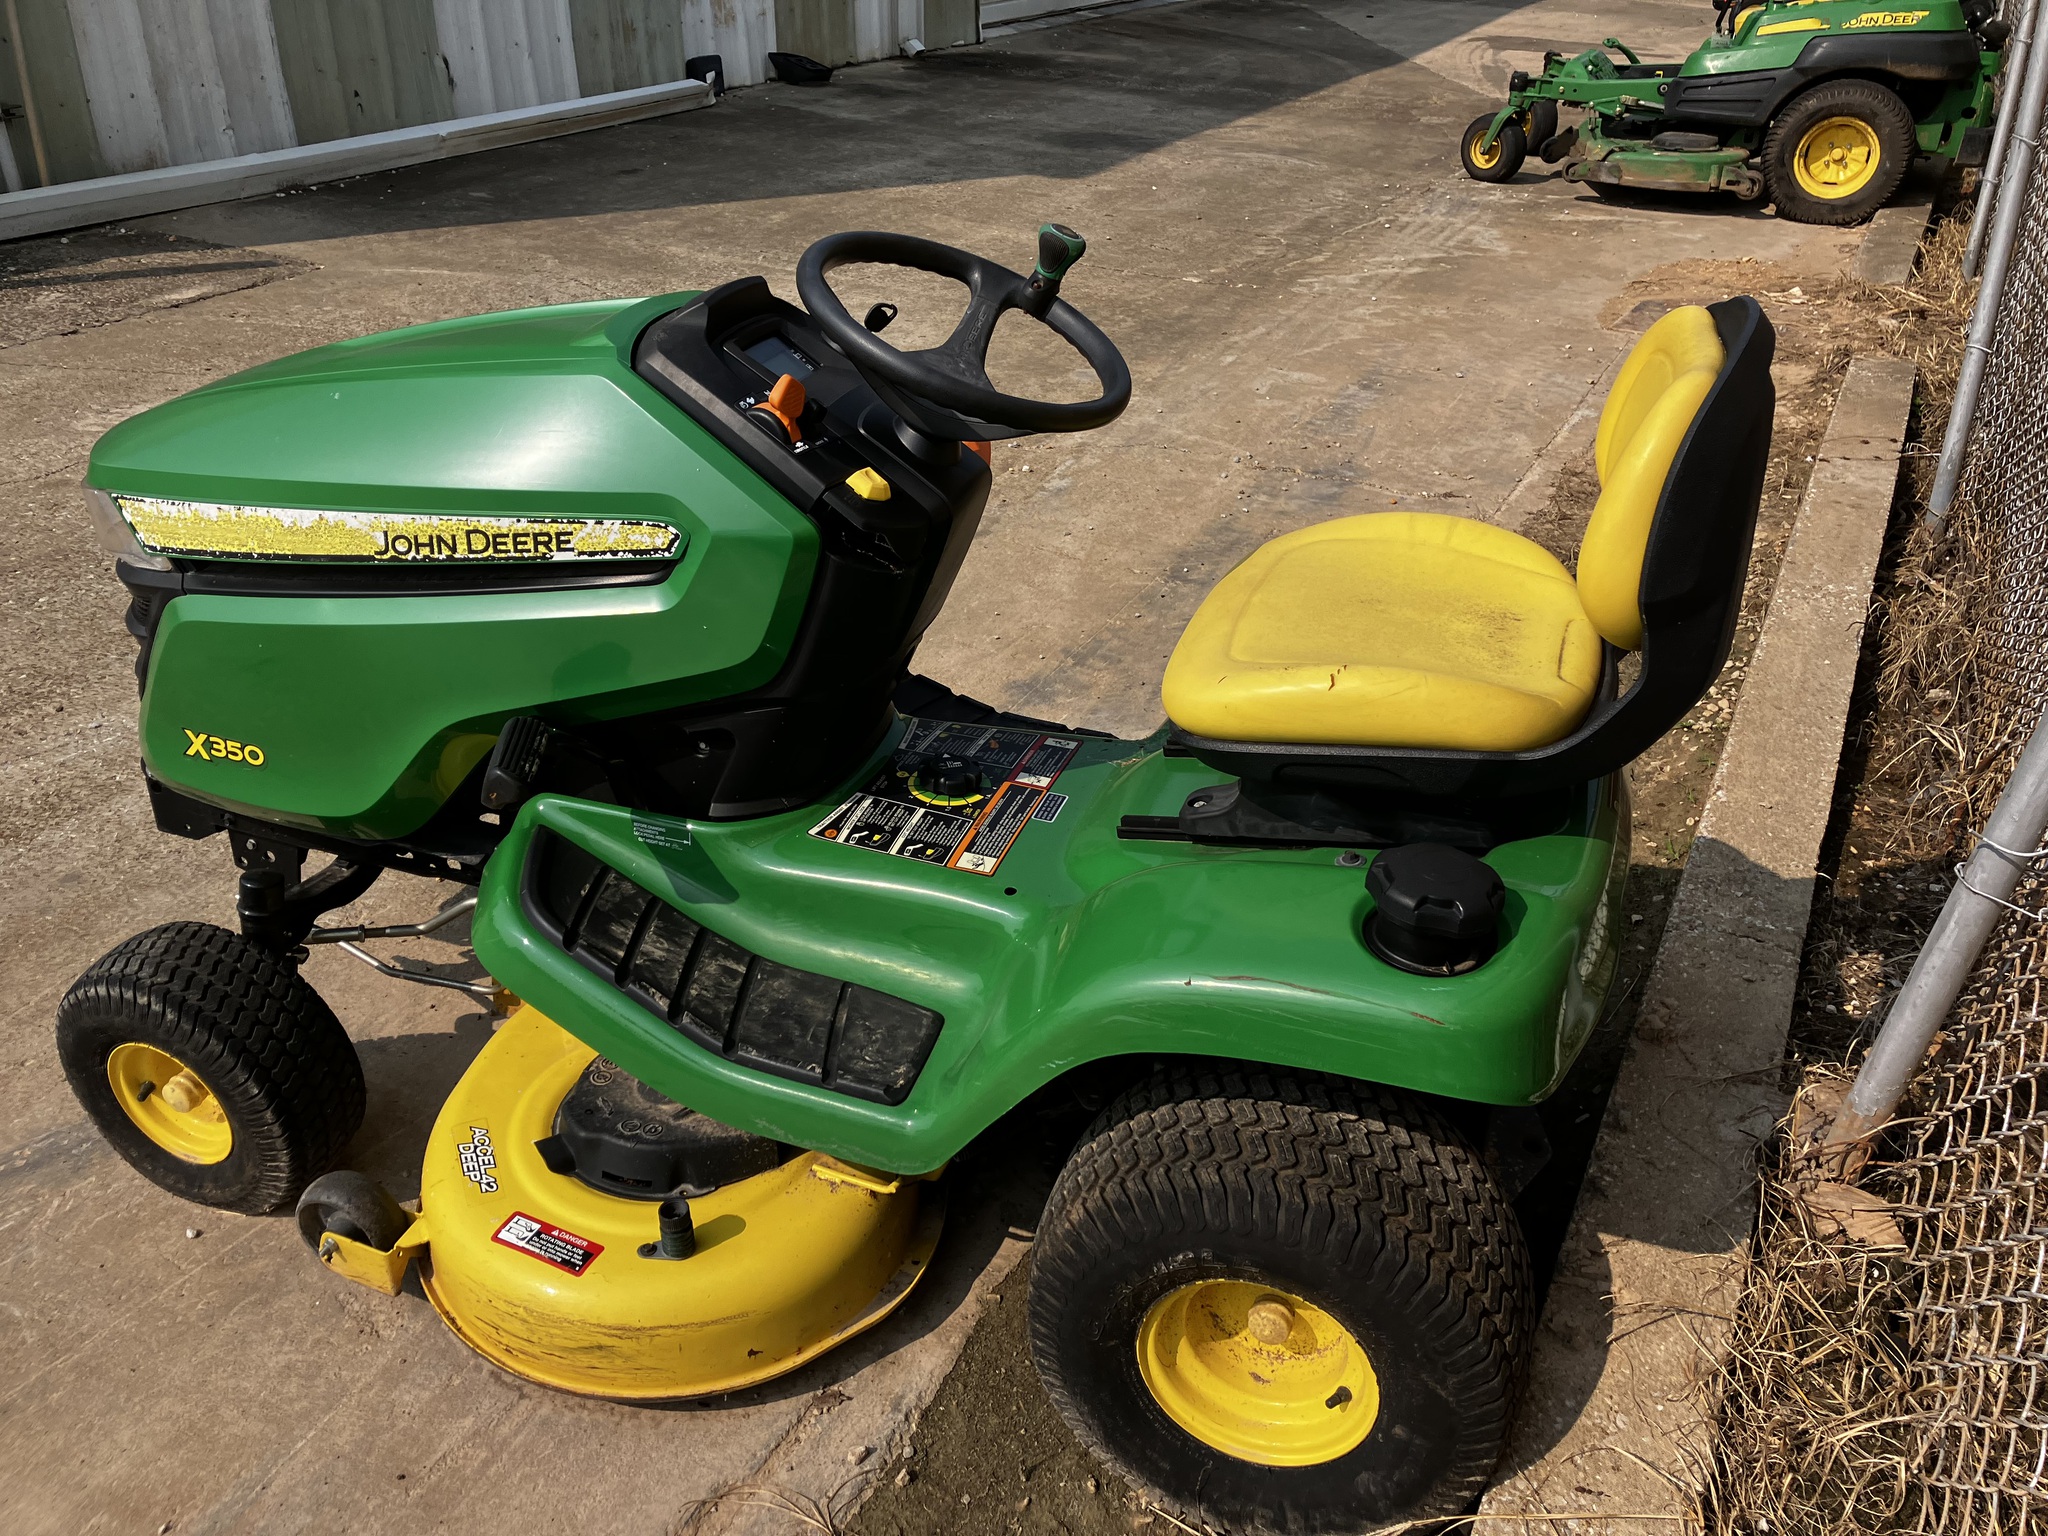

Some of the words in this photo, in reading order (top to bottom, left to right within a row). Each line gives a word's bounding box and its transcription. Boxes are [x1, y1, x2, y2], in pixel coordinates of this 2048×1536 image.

[374, 530, 458, 556] JOHN
[465, 529, 575, 555] DEERE
[182, 728, 265, 767] X350
[457, 1142, 481, 1183] DEEP
[540, 1233, 566, 1247] ROTATING
[566, 1243, 585, 1255] BLADE
[554, 1245, 568, 1254] hands
[559, 1231, 588, 1248] DANGER
[571, 1257, 583, 1266] when
